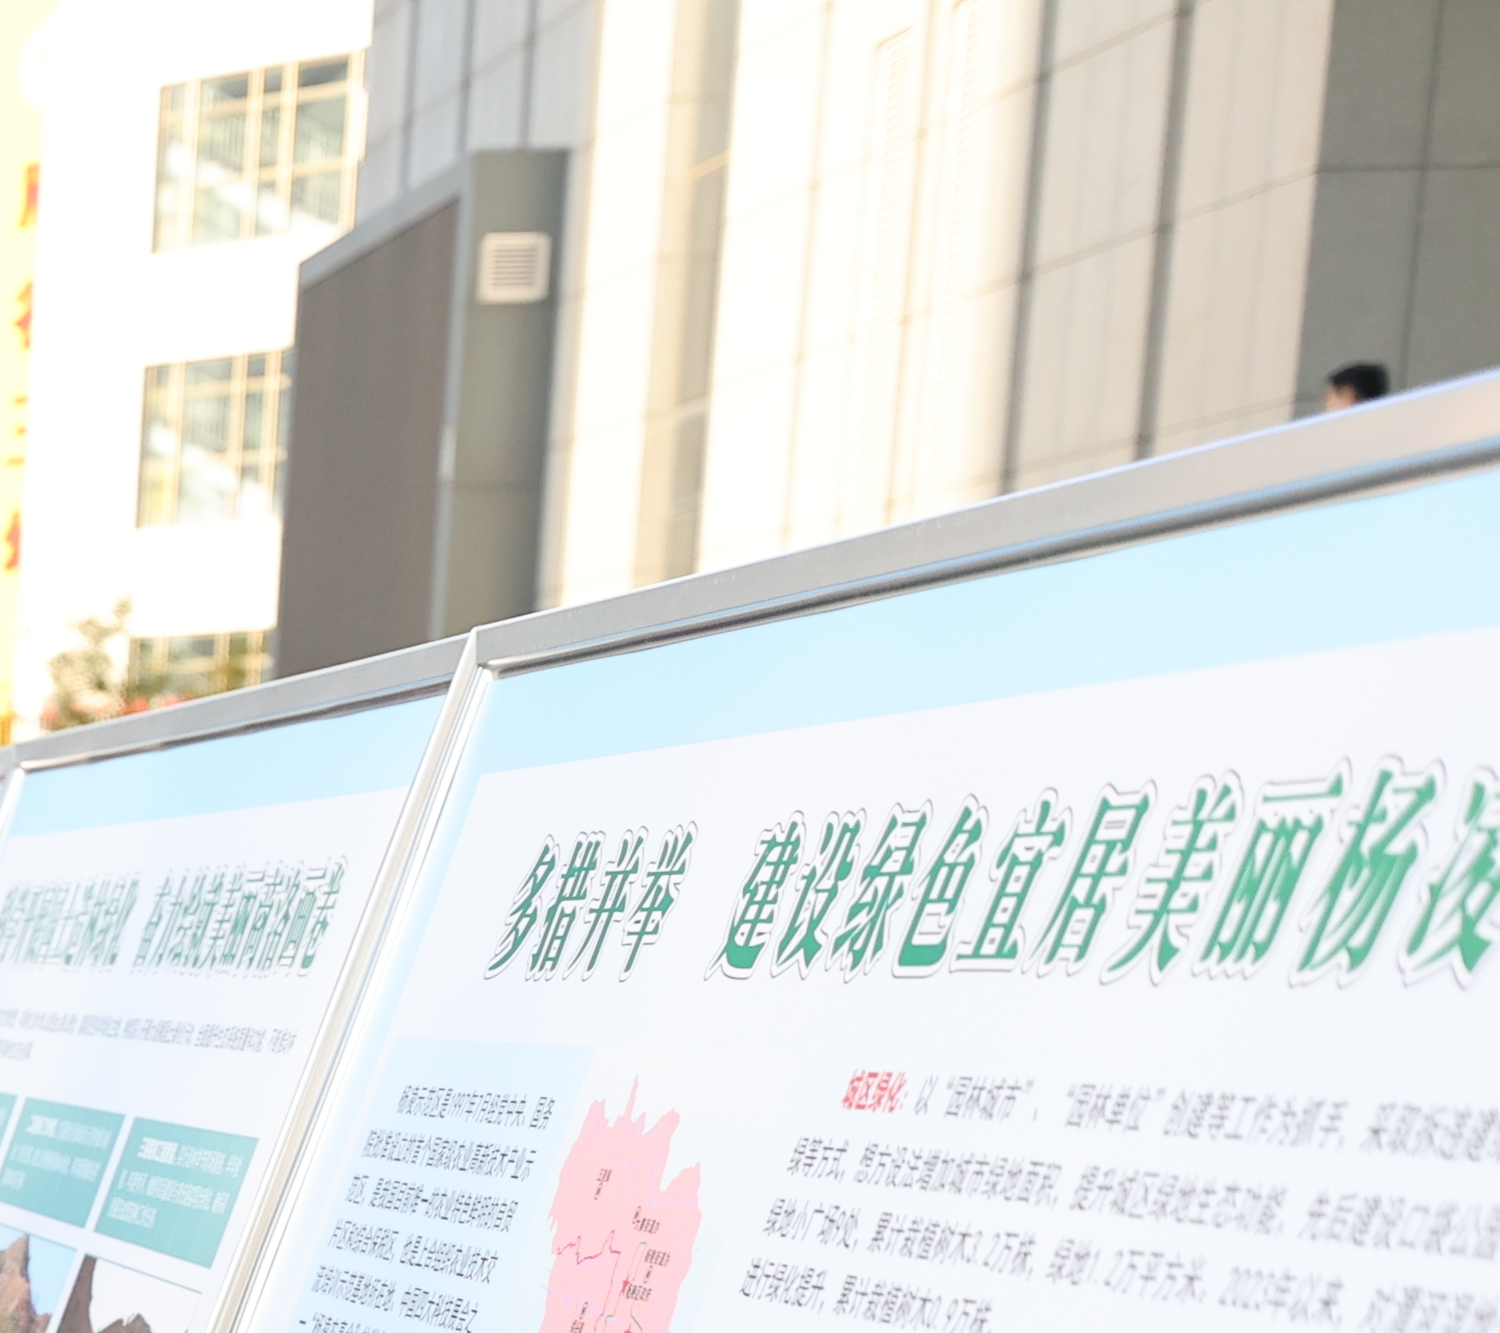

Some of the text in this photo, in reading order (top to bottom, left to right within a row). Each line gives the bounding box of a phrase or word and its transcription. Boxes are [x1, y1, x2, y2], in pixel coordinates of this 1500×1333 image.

[484, 752, 1500, 990] 多措并举 建设绿色宜居美丽杨凌
